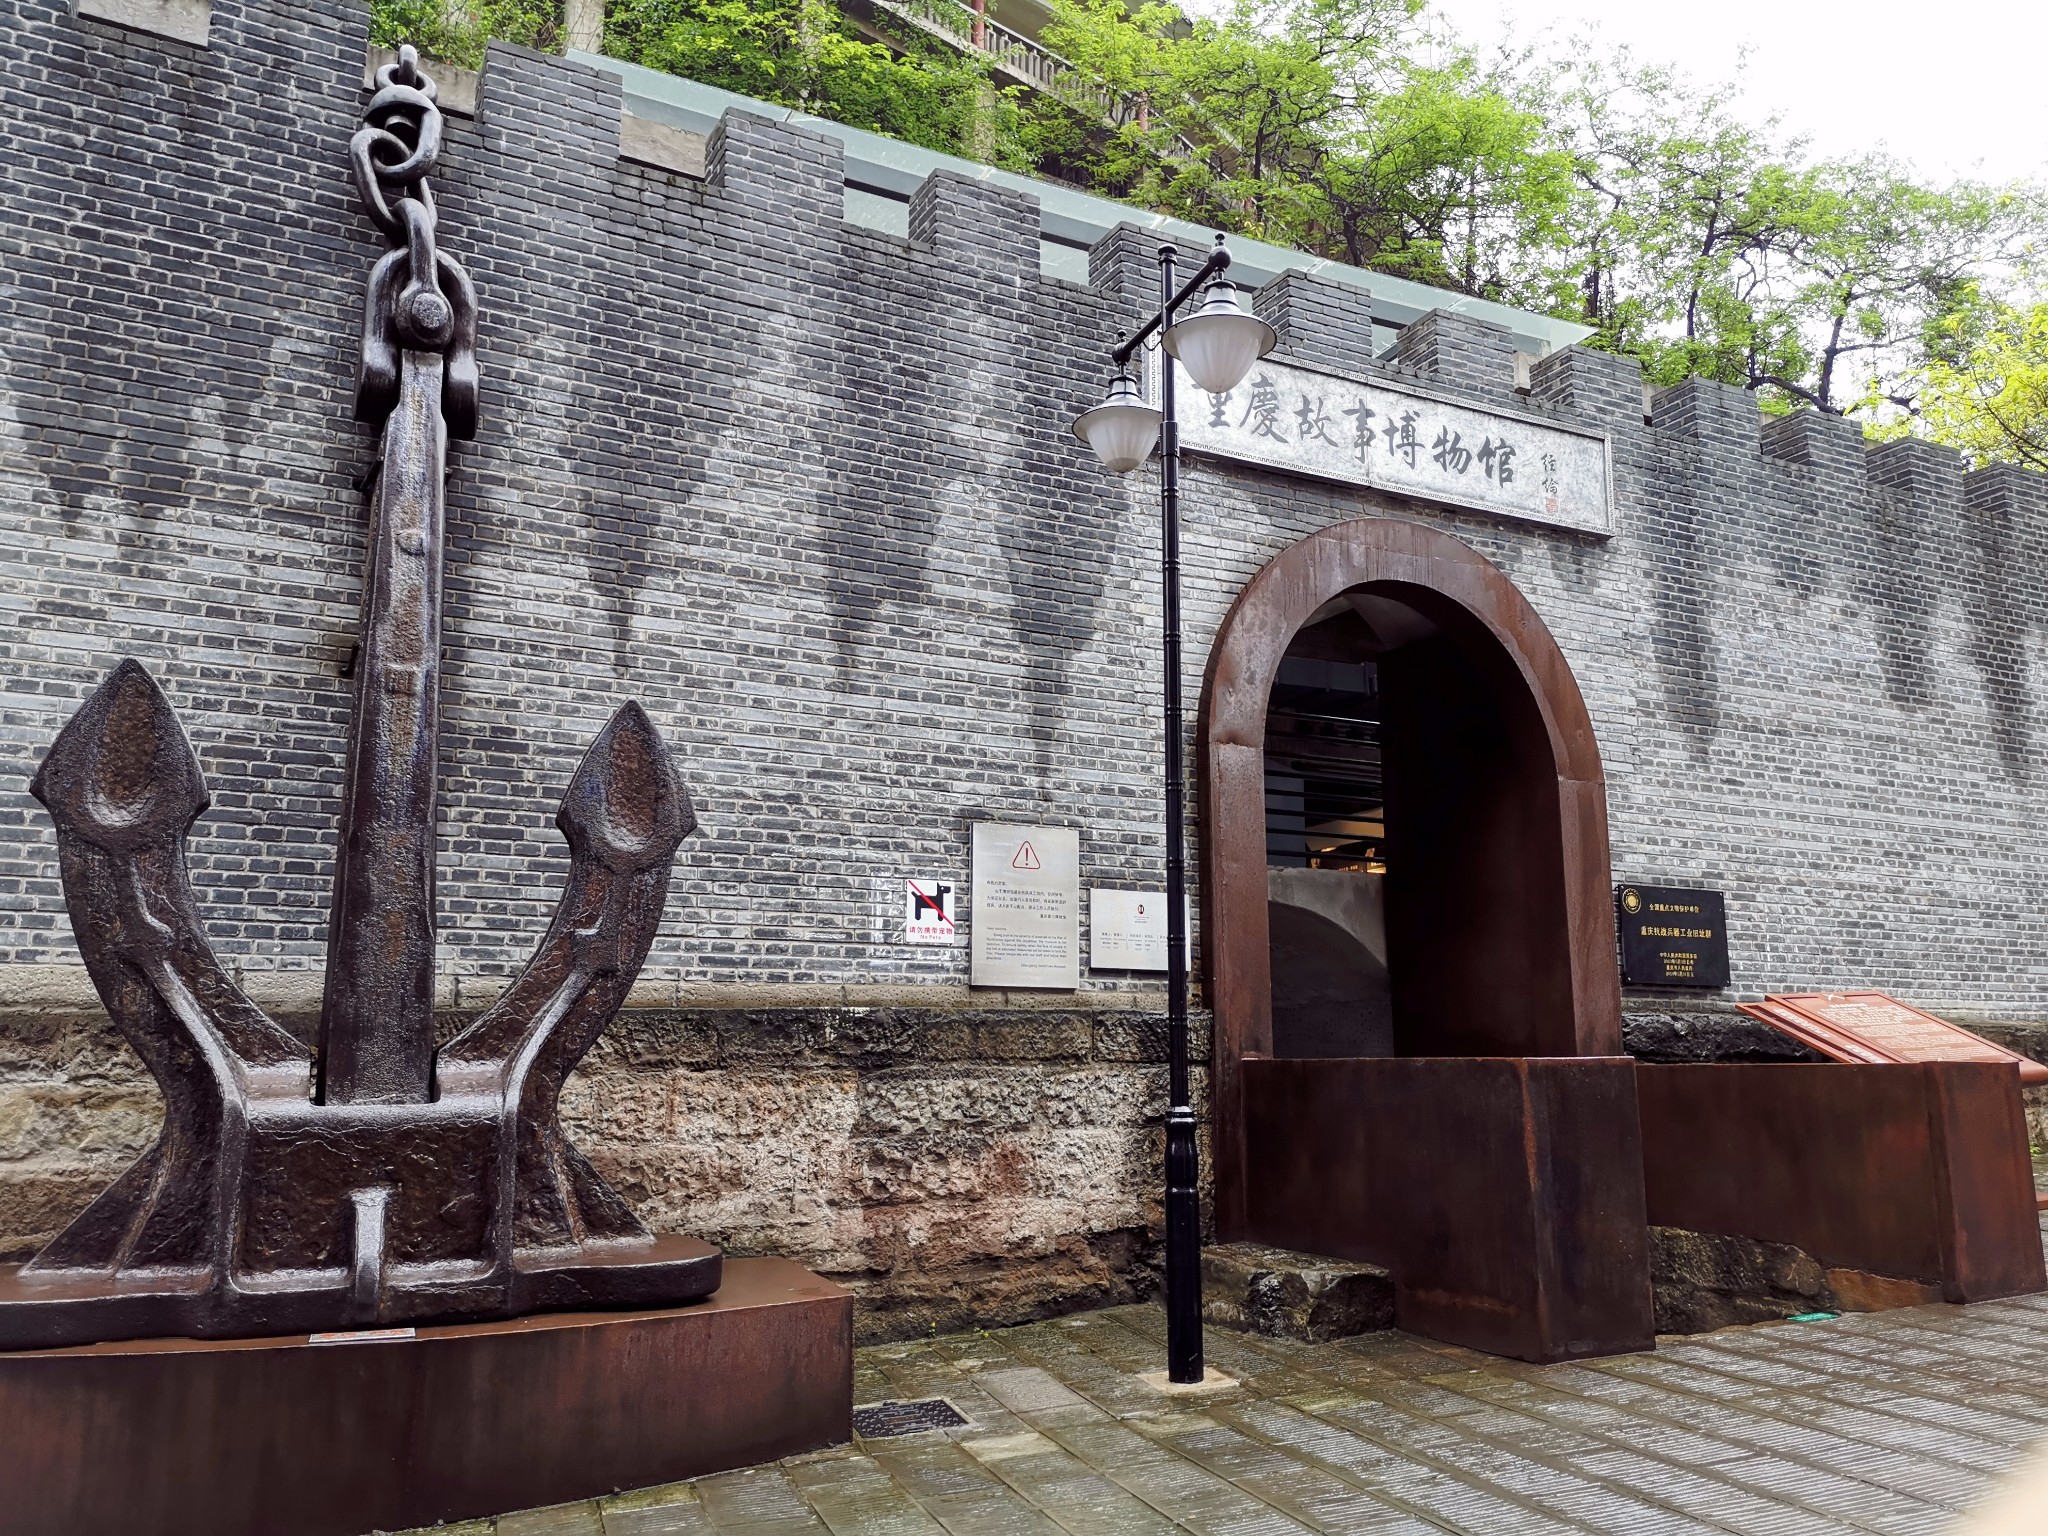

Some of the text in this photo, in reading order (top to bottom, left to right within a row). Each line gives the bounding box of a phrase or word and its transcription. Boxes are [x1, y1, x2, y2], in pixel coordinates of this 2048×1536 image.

[1649, 903, 1700, 913] 全国重点文物保护单位
[909, 926, 953, 935] 请勿携带宠物
[1640, 925, 1712, 939] 重庆抗战兵器工业旧址群
